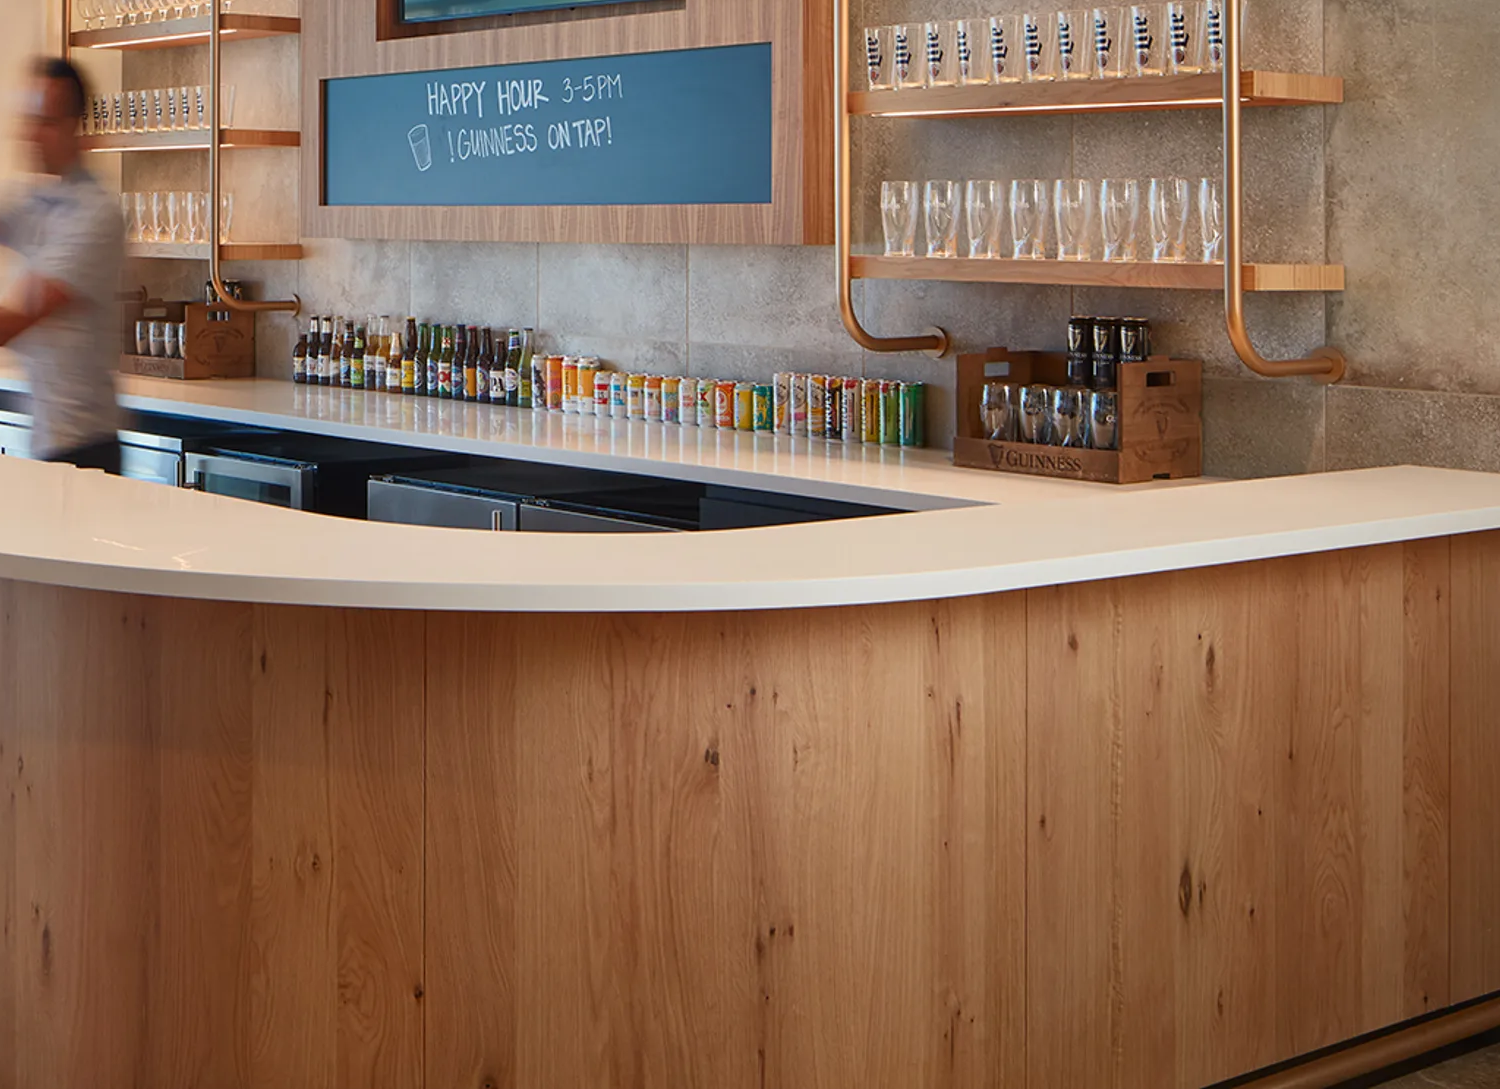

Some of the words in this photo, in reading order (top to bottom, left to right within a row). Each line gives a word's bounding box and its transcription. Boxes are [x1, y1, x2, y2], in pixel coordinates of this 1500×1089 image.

[427, 81, 486, 118] HAPPY
[497, 79, 549, 115] HOUR
[562, 74, 623, 103] 3-5PM
[548, 120, 571, 150] ON
[572, 116, 612, 149] TAP!
[1006, 449, 1082, 472] GUINNESS
